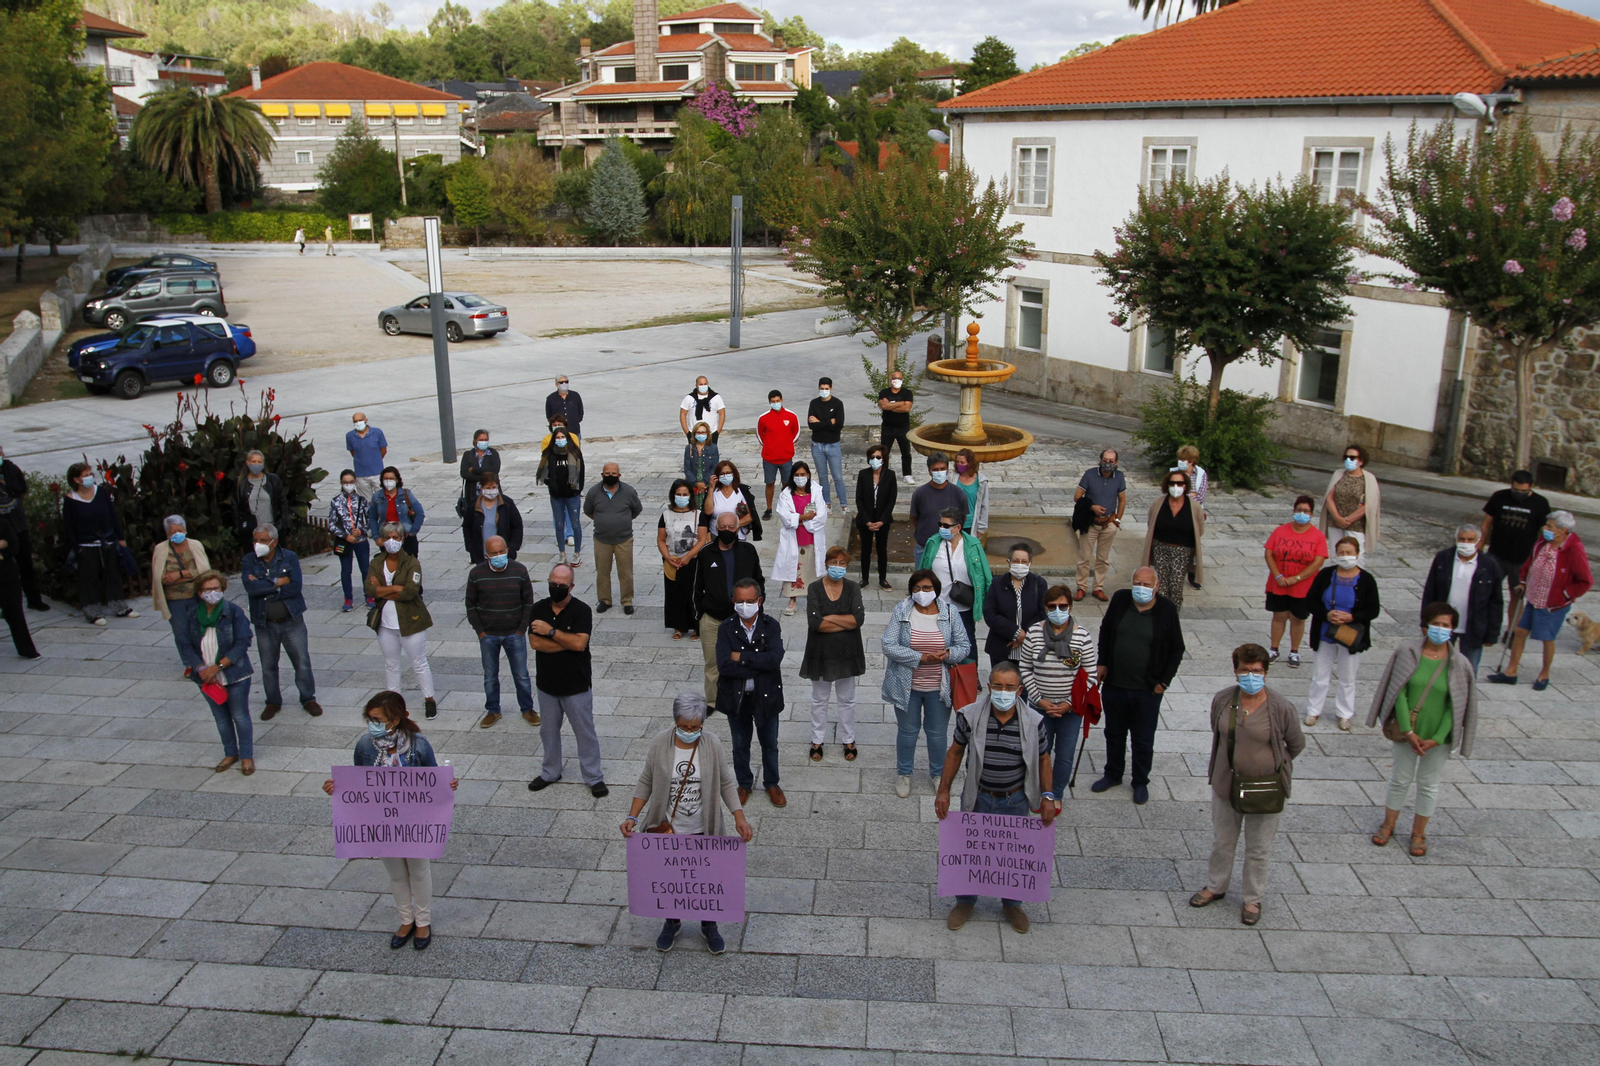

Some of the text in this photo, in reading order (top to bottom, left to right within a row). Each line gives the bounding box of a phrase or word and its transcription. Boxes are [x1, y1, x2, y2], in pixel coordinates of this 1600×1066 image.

[365, 769, 437, 787] ENTRIMO
[342, 791, 370, 803] COAS
[384, 807, 399, 818] DA
[961, 813, 1043, 831] AS MULLERES
[335, 821, 447, 844] VIOLENCIA MACHISTA
[966, 828, 1019, 840] DO RURAL
[641, 837, 651, 850] O
[664, 855, 711, 867] XAMAIS
[941, 854, 1047, 873] CONTRA A VIOLENCIA
[681, 869, 696, 879] TE
[968, 868, 1036, 890] MACHISTA
[656, 896, 724, 912] L. MIGUEL
